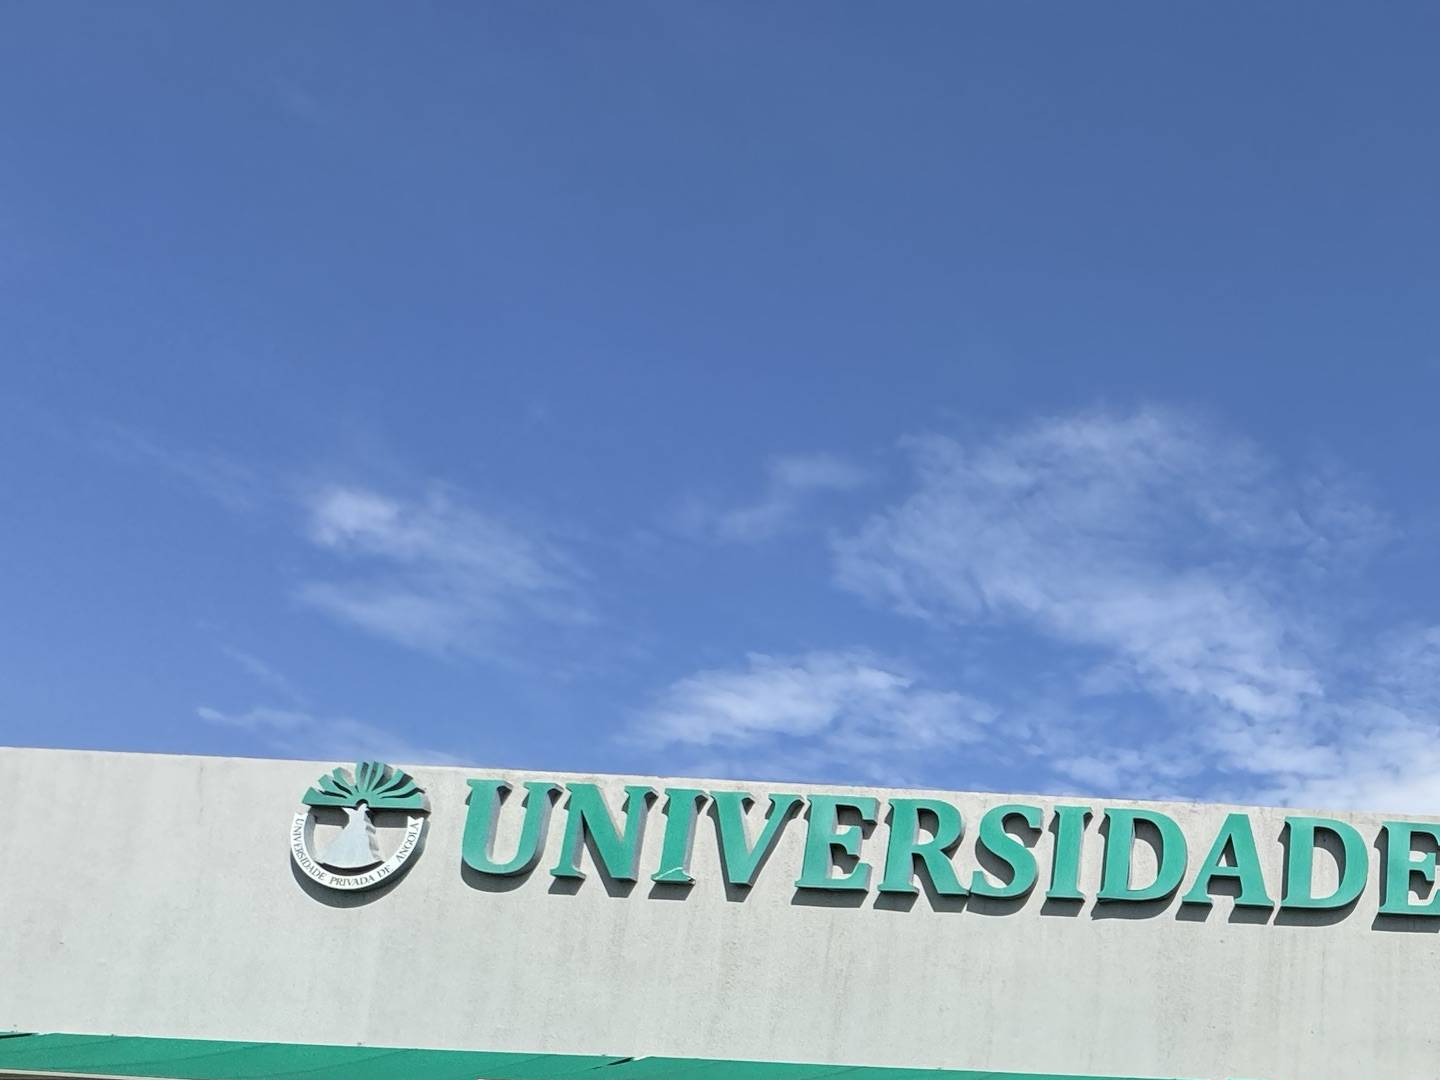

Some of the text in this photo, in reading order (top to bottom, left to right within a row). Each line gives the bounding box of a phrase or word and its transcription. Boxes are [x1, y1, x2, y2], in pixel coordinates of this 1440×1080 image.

[292, 818, 420, 887] UNIVERSIDADE PRIVADA DE ANGOLA
